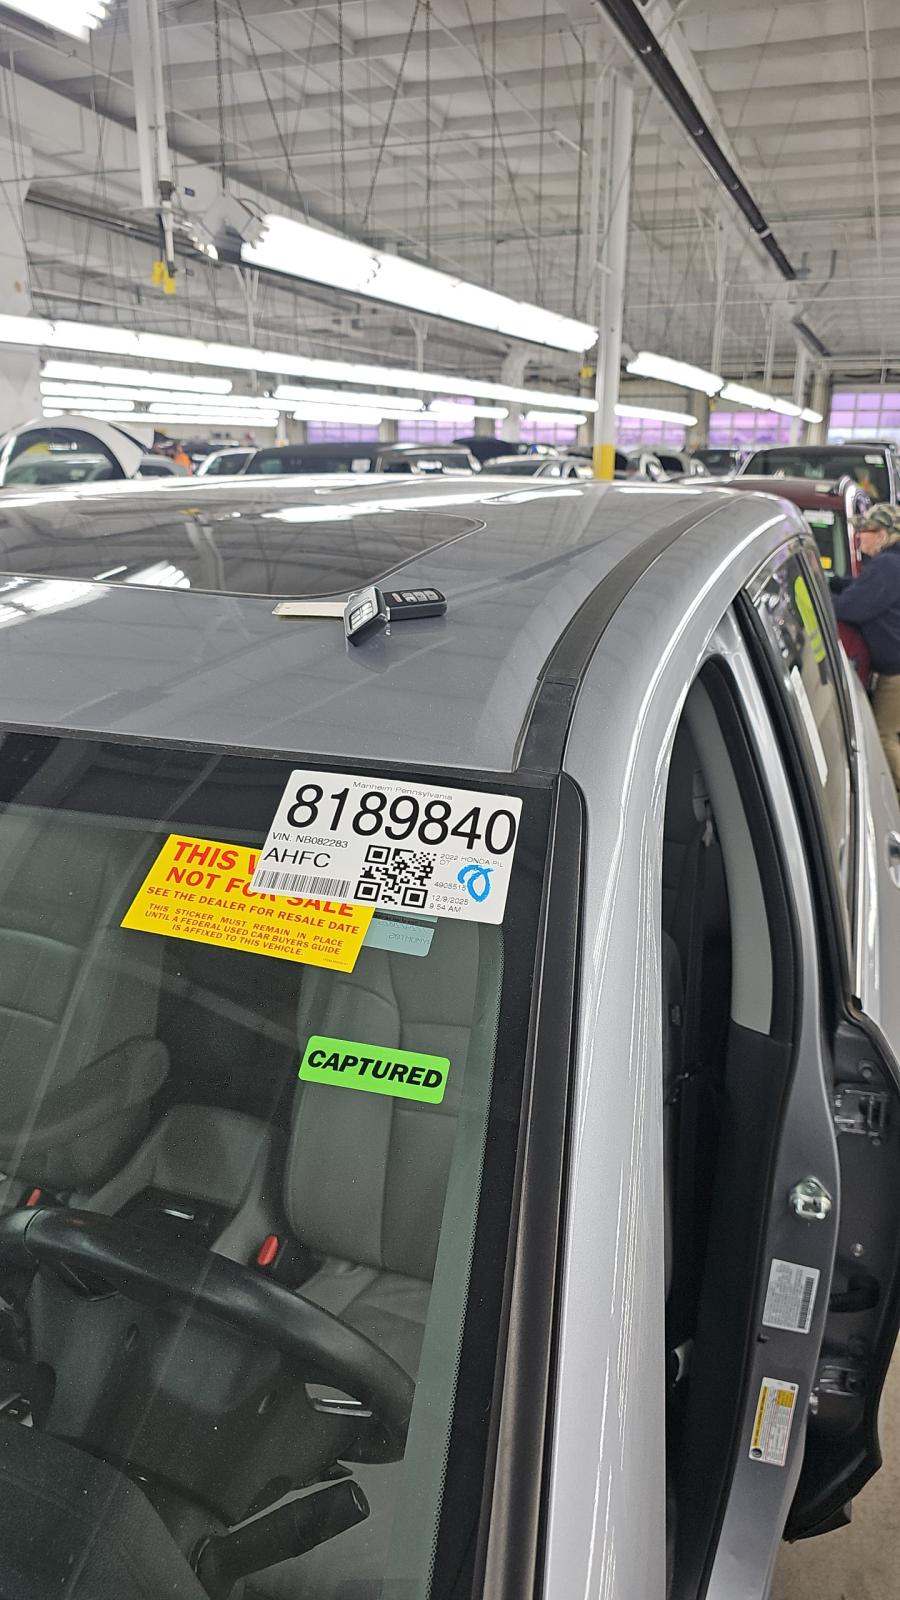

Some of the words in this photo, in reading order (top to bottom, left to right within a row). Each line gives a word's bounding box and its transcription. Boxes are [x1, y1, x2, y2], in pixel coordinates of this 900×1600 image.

[353, 781, 393, 792] Manheim
[395, 787, 453, 800] Pennsylvania
[287, 784, 516, 855] 8189840
[272, 832, 292, 842] VIN:
[295, 834, 349, 848] NB082283
[173, 841, 239, 871] THIS
[263, 847, 331, 868] AHFC
[440, 853, 459, 861] 2022
[461, 856, 490, 865] HONDA
[165, 866, 221, 890] NOT
[146, 886, 171, 898] SEE
[173, 890, 197, 902] THE
[199, 895, 247, 912] DEALER
[249, 905, 275, 918] FOR
[277, 910, 326, 928] RESALE
[328, 921, 361, 935] DATE
[432, 894, 469, 906] 12/9/2025
[447, 905, 462, 913] AM
[145, 910, 170, 921] UNTIL
[181, 917, 222, 931] FEDERAL
[224, 925, 249, 936] USED
[250, 930, 271, 942] CAR
[272, 935, 309, 948] BUYERS
[311, 943, 342, 955] GUIDE
[149, 902, 169, 912] THIS
[175, 907, 214, 921] STICKER
[220, 916, 248, 927] MUST
[253, 923, 291, 936] REMAIN
[297, 932, 307, 940] IN
[313, 935, 344, 948] PLACE
[183, 926, 223, 939] AFFIXED
[225, 933, 237, 942] TO
[240, 936, 260, 947] THIS
[263, 940, 304, 956] VEHICLE.
[307, 1049, 443, 1088] CAPTURED
